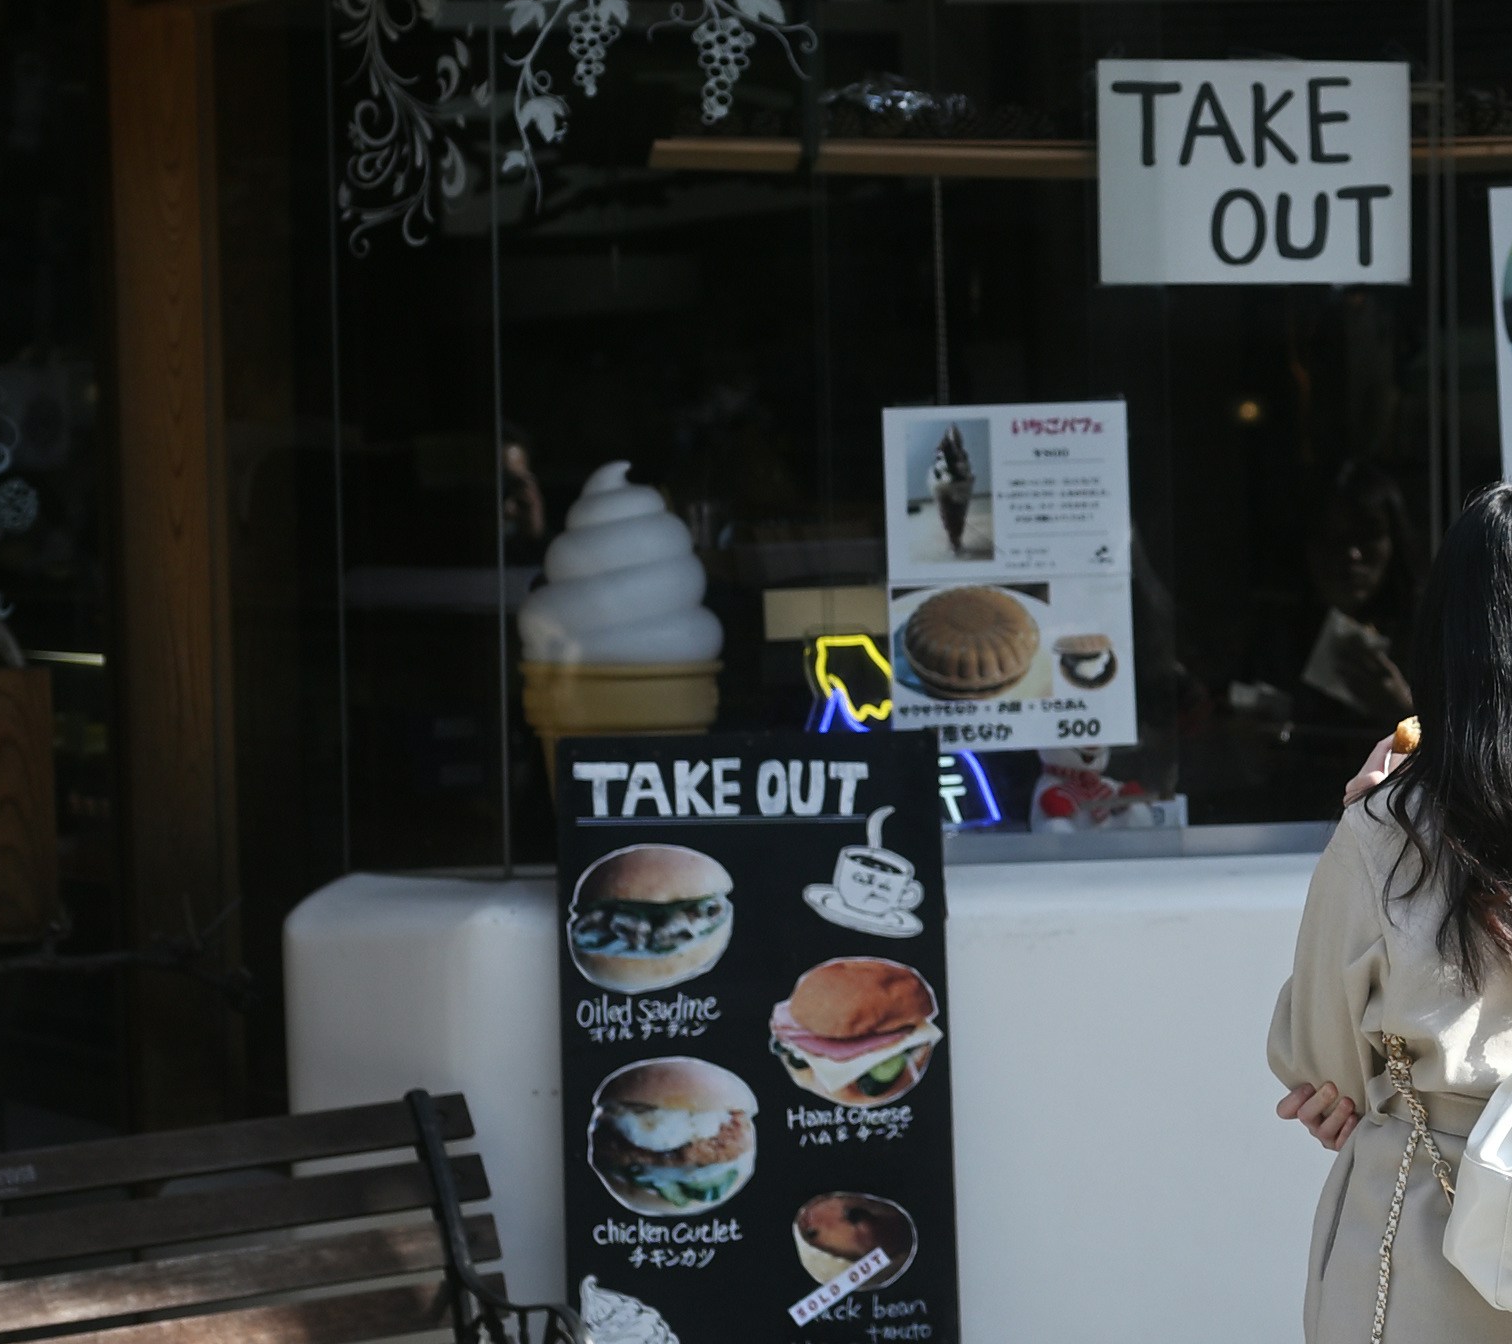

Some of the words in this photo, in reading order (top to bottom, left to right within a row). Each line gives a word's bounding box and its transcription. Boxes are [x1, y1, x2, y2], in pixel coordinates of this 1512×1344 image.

[1111, 76, 1351, 169] TAKE
[1210, 184, 1393, 268] OUT
[1056, 717, 1102, 740] 500
[572, 758, 742, 817] TAKE
[757, 758, 869, 817] OUT
[849, 1254, 882, 1283] OUT
